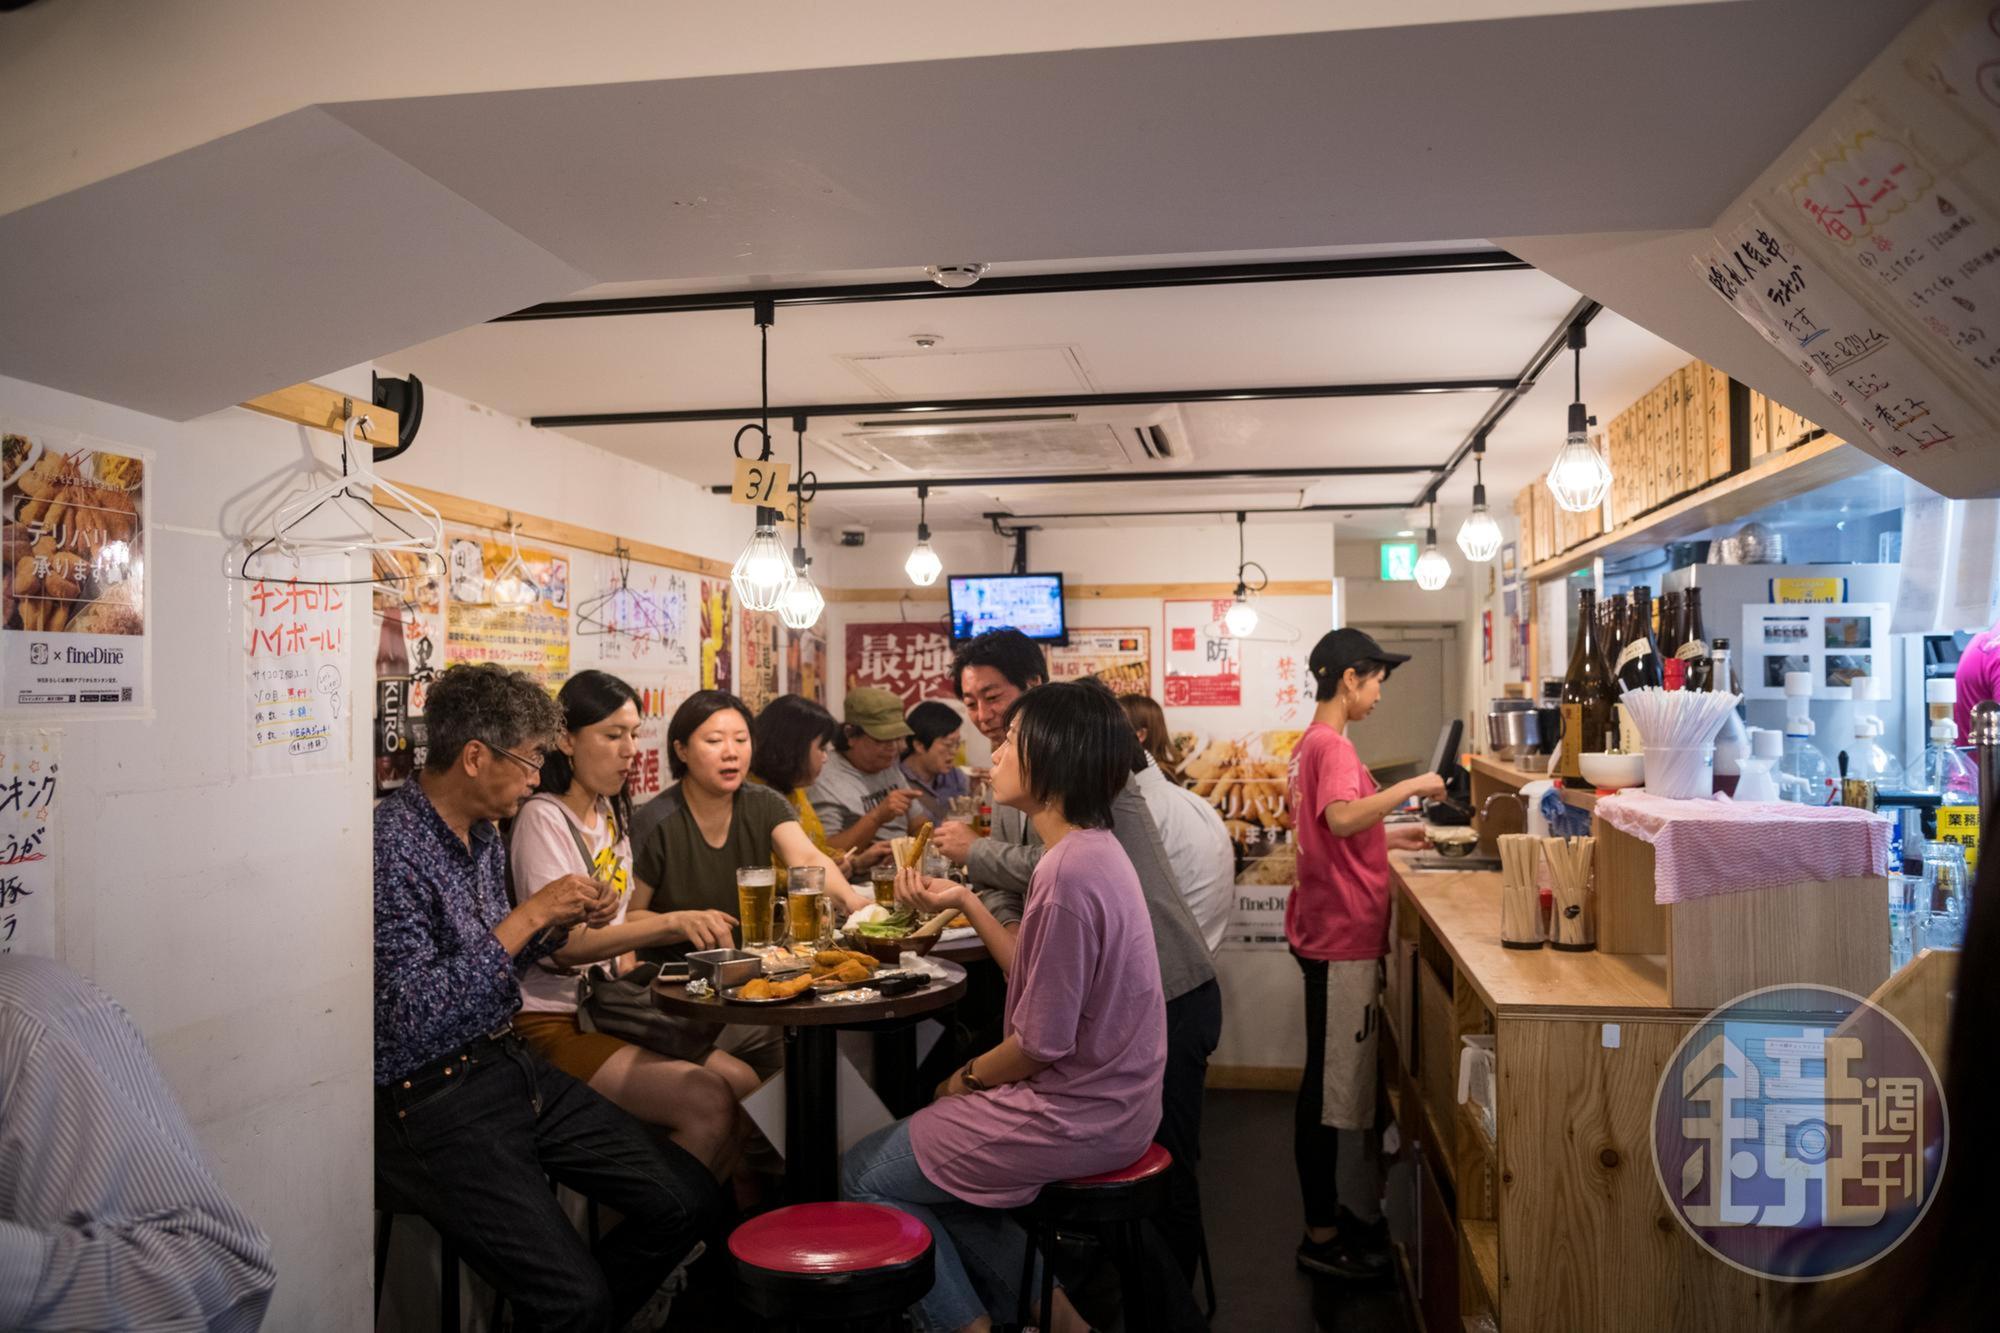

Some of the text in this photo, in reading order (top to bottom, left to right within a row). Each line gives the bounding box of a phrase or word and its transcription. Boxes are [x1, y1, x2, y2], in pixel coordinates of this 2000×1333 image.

[1803, 163, 1906, 241] 春メニュー
[1708, 229, 1788, 301] 隠れ人気串
[1767, 264, 1806, 307] ランキング
[1782, 307, 1817, 342] きす
[745, 467, 776, 501] 31
[27, 520, 108, 549] デリバリ
[250, 576, 343, 617] チンチロリン
[66, 645, 123, 665] fineDine
[250, 621, 342, 656] ハイボール!
[385, 681, 399, 753] KURO
[1220, 796, 1285, 819] リバリ
[0, 827, 46, 864] うが
[1239, 896, 1287, 911] fineDi
